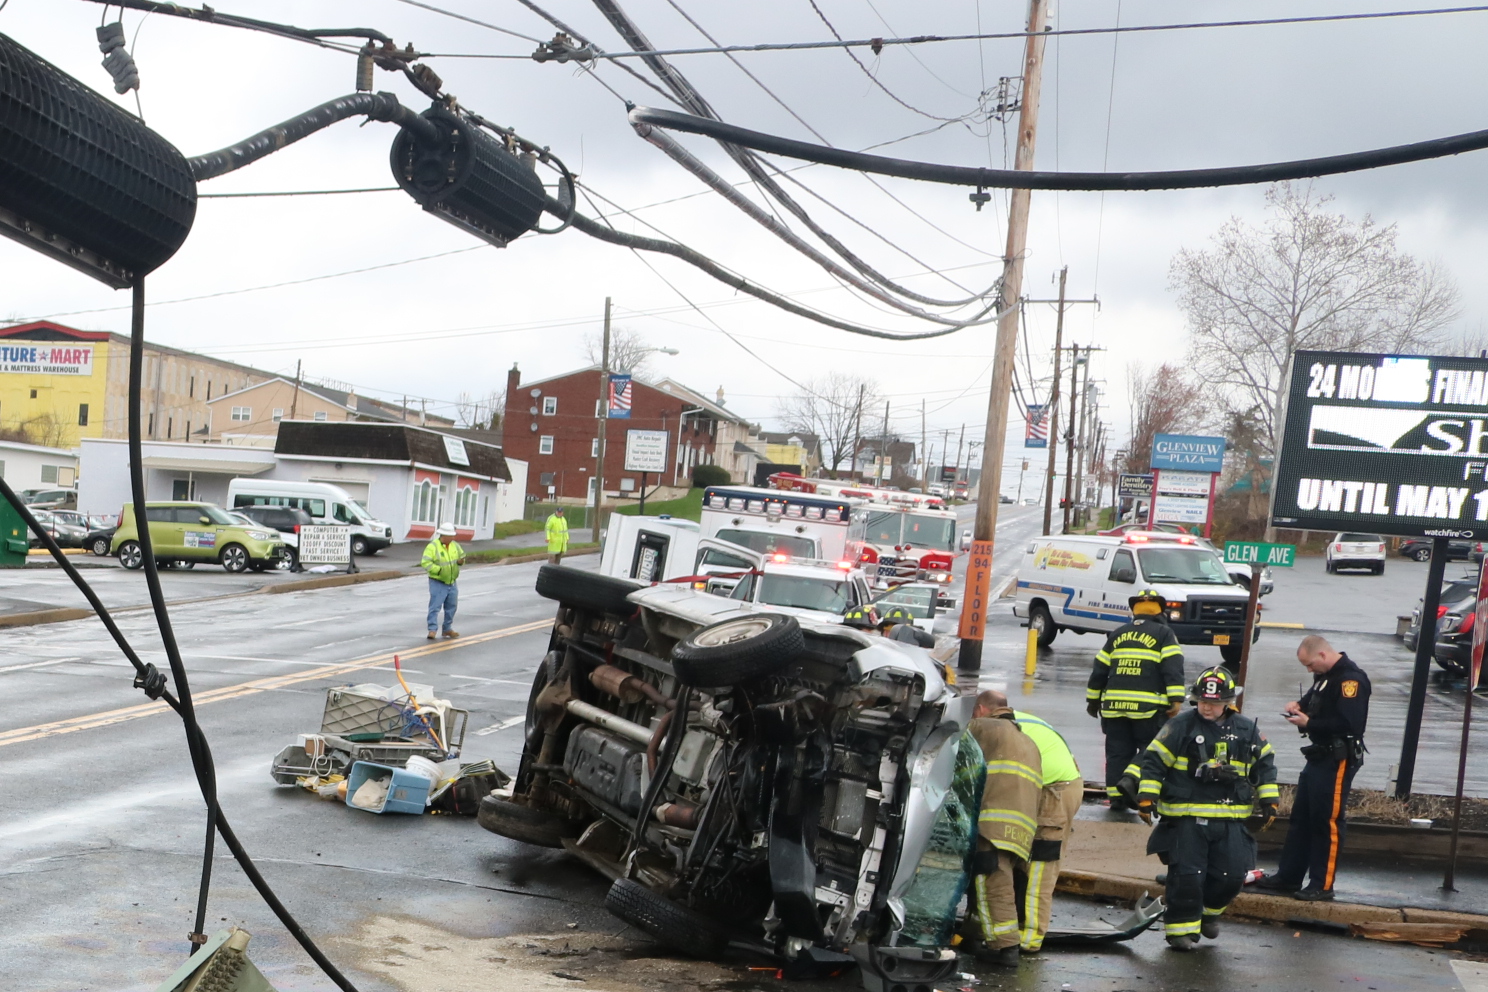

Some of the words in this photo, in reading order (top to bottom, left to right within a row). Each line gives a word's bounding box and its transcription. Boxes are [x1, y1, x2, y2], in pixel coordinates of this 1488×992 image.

[50, 348, 91, 365] MART
[43, 366, 79, 374] WAREHOUSE
[1307, 362, 1337, 399] 24
[1156, 441, 1221, 455] GLENVIEW
[1169, 454, 1204, 464] PLAZA
[1297, 478, 1390, 515] UNTIL
[1395, 484, 1470, 519] MAY
[1424, 528, 1461, 538] watchfire
[973, 545, 992, 555] 215
[1227, 544, 1259, 563] GLEN
[1267, 546, 1291, 564] AVE
[969, 571, 984, 636] FLOOR
[1088, 600, 1100, 608] FIRE
[1113, 631, 1157, 649] PARKLAND
[1118, 658, 1141, 667] SAFETY
[1116, 667, 1141, 676] OFFICER
[1206, 681, 1217, 694] 9
